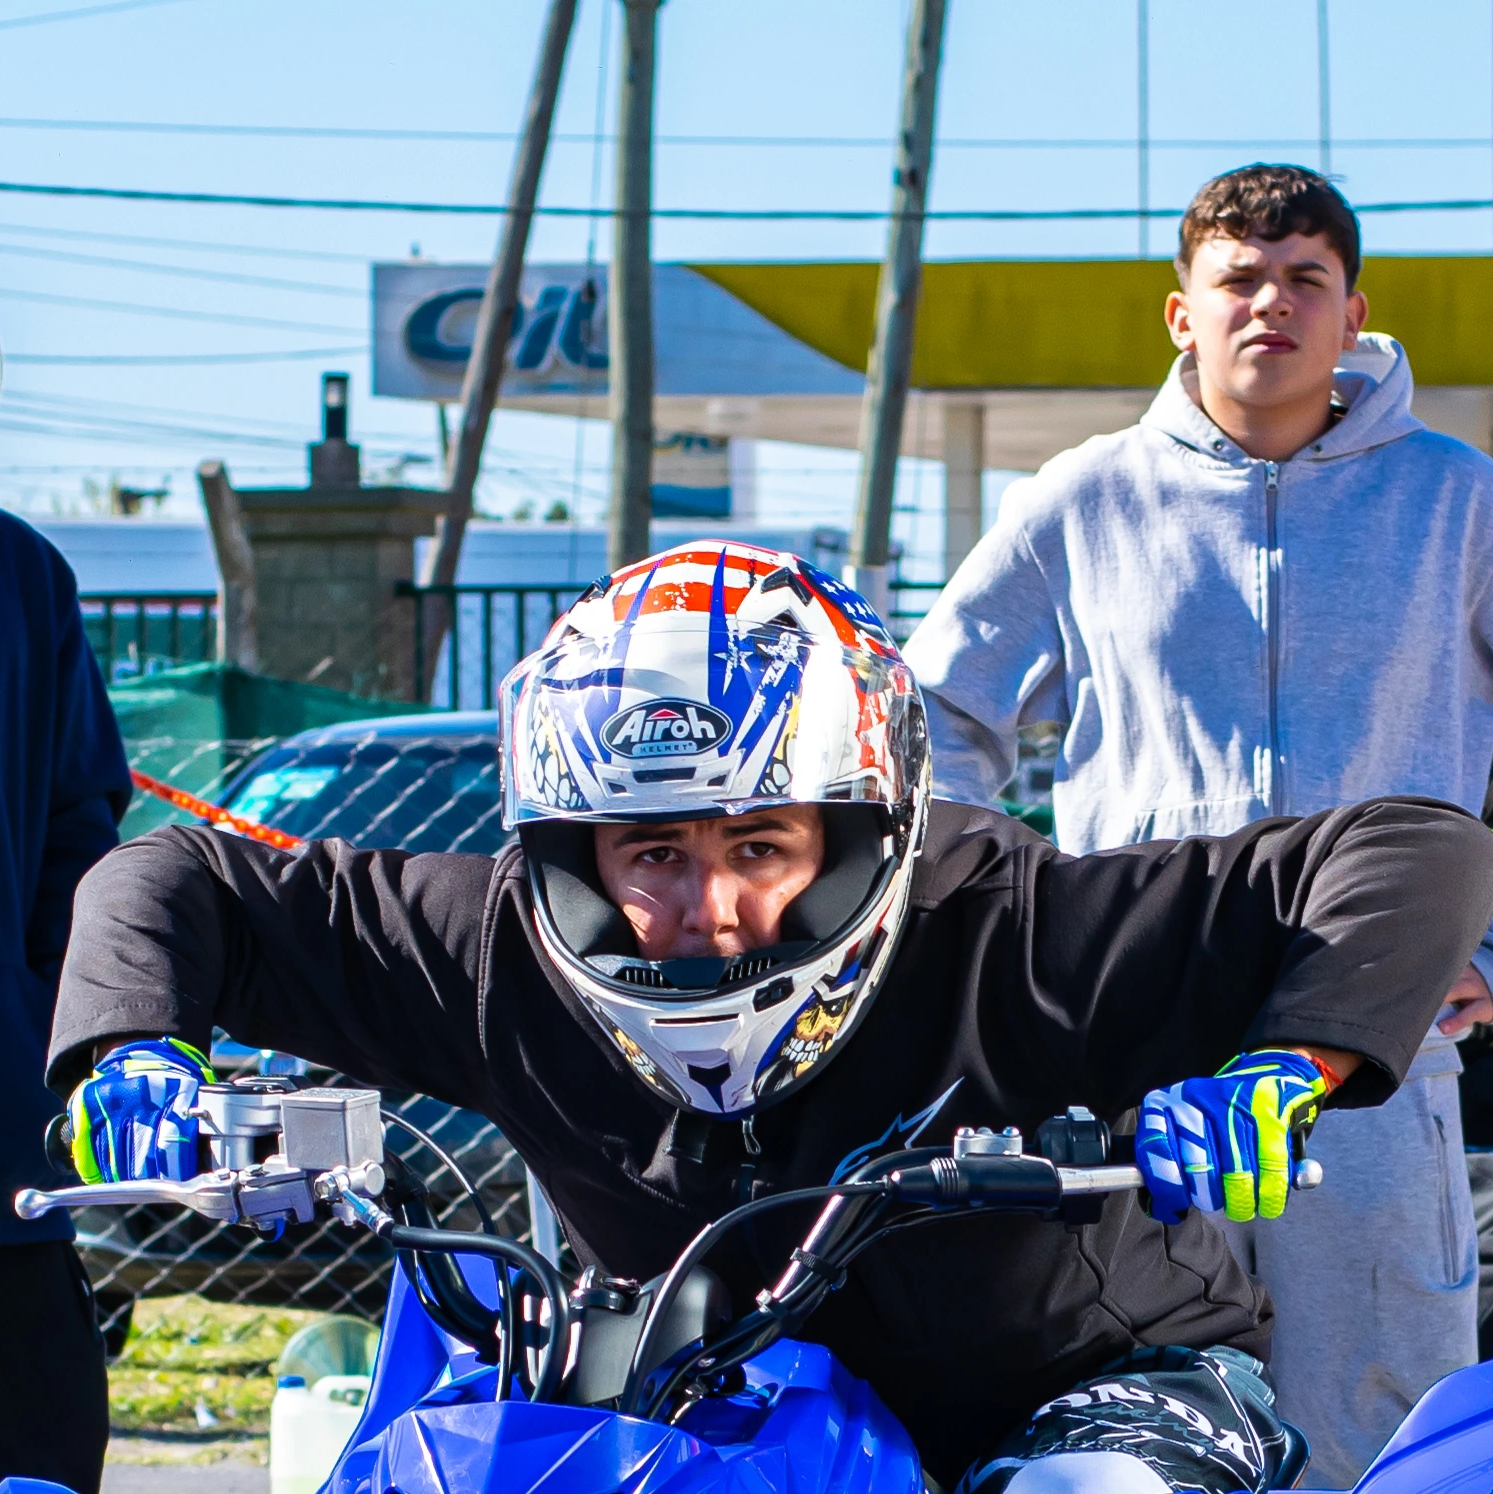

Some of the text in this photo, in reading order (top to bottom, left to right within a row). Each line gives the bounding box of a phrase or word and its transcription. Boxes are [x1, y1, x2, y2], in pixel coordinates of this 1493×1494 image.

[611, 706, 717, 746] Airoh
[639, 743, 687, 754] HELMET
[1026, 1383, 1257, 1478] ONDA
